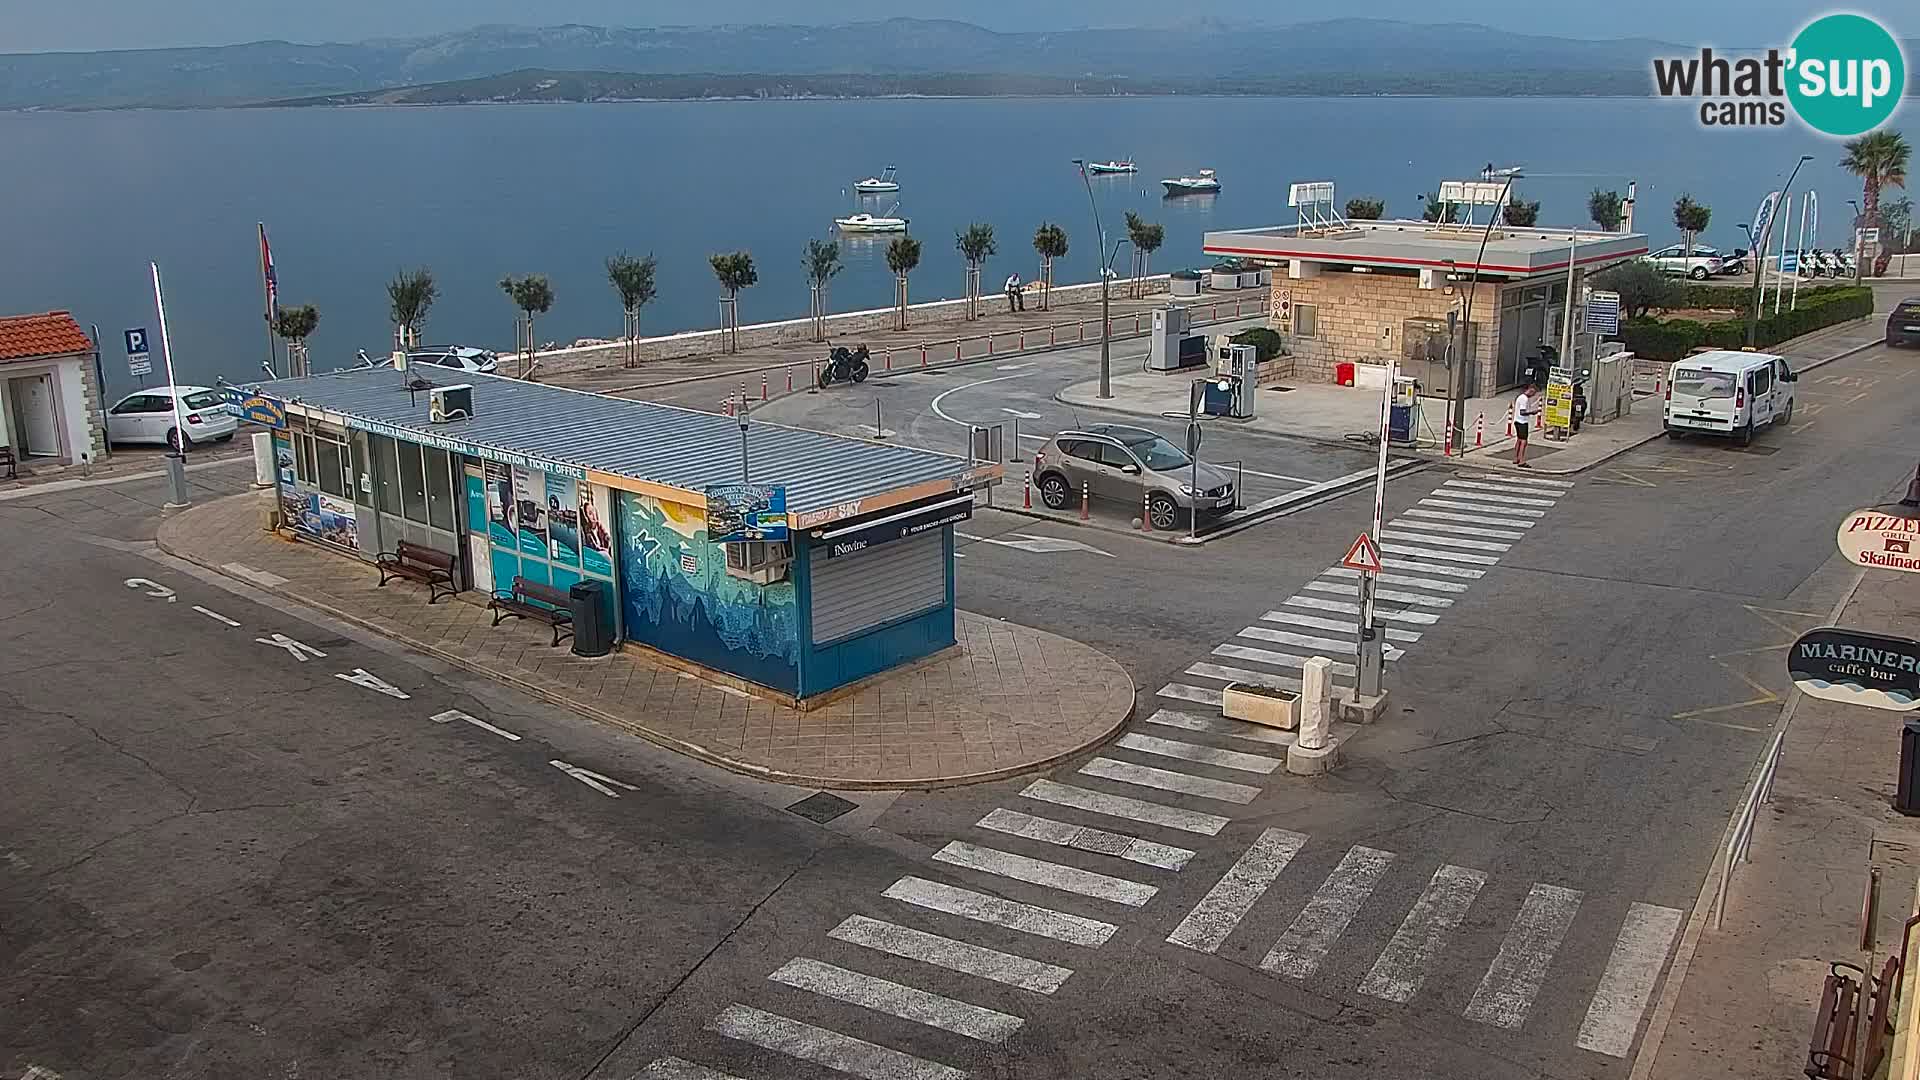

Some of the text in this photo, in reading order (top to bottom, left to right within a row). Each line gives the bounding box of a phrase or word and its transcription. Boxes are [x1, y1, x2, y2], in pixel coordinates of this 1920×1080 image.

[130, 332, 142, 350] P
[395, 428, 436, 446] AUTOBUSNA
[436, 437, 467, 452] POSTAJA
[478, 447, 493, 459] BUS
[494, 450, 526, 466] STATION
[528, 457, 553, 472] TICKET
[555, 464, 582, 478] OFFICE
[1881, 531, 1916, 542] GRILL
[1828, 663, 1896, 681] caffe bar
